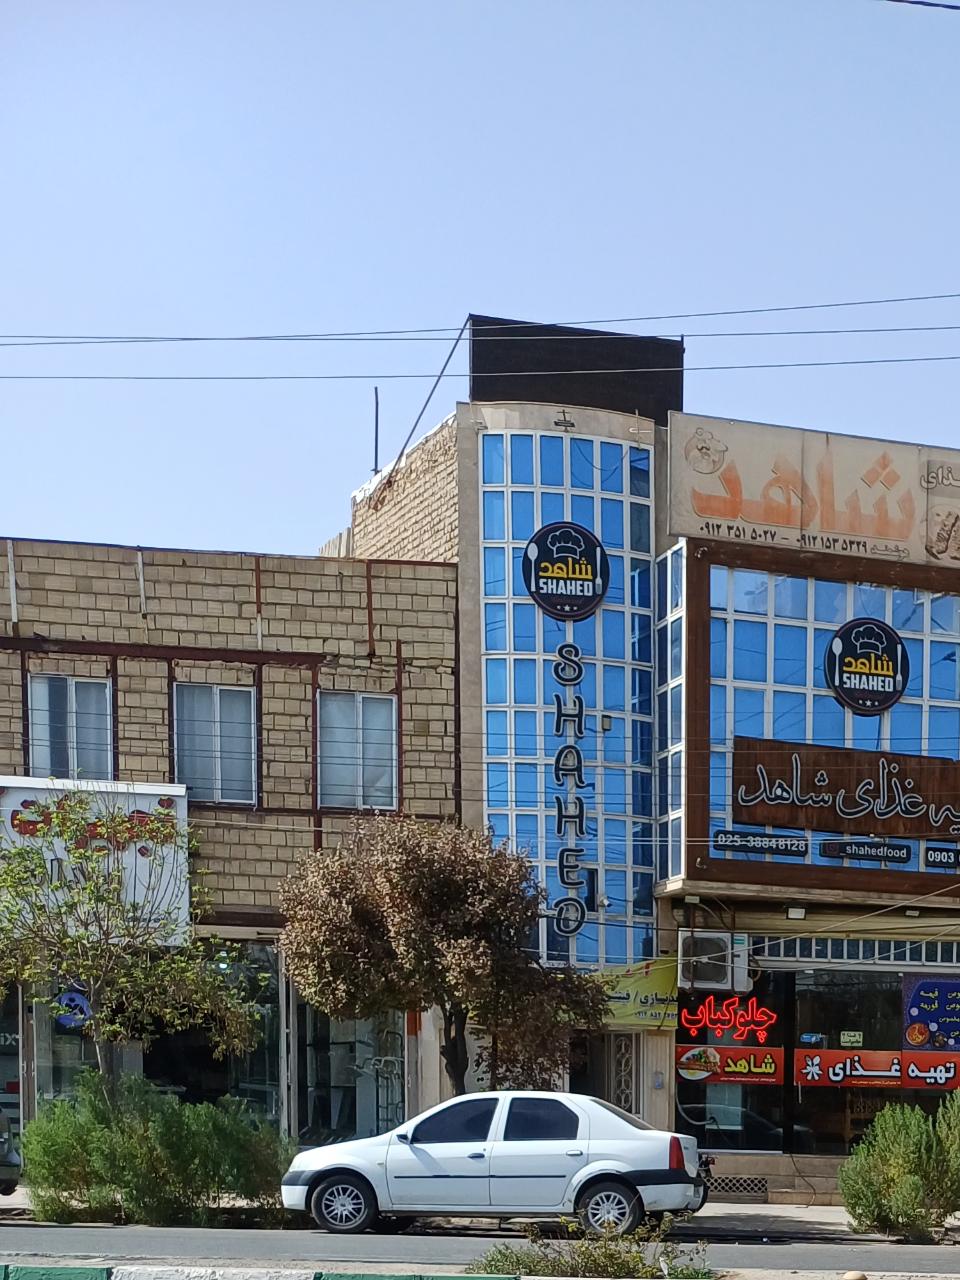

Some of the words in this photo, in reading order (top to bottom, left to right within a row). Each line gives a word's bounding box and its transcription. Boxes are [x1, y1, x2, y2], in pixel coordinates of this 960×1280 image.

[691, 450, 917, 542] شاهد
[539, 556, 593, 580] شاهد
[539, 578, 593, 597] SHAHED
[843, 653, 894, 677] شاهد
[842, 672, 894, 693] SHAHED
[552, 643, 588, 937] SHAHED
[736, 753, 833, 808] شاهد
[836, 758, 928, 820] غذای
[928, 850, 955, 863] 0903
[723, 1053, 776, 1074] شاهد
[828, 1055, 901, 1082] غذای
[907, 1060, 957, 1085] تهیه
